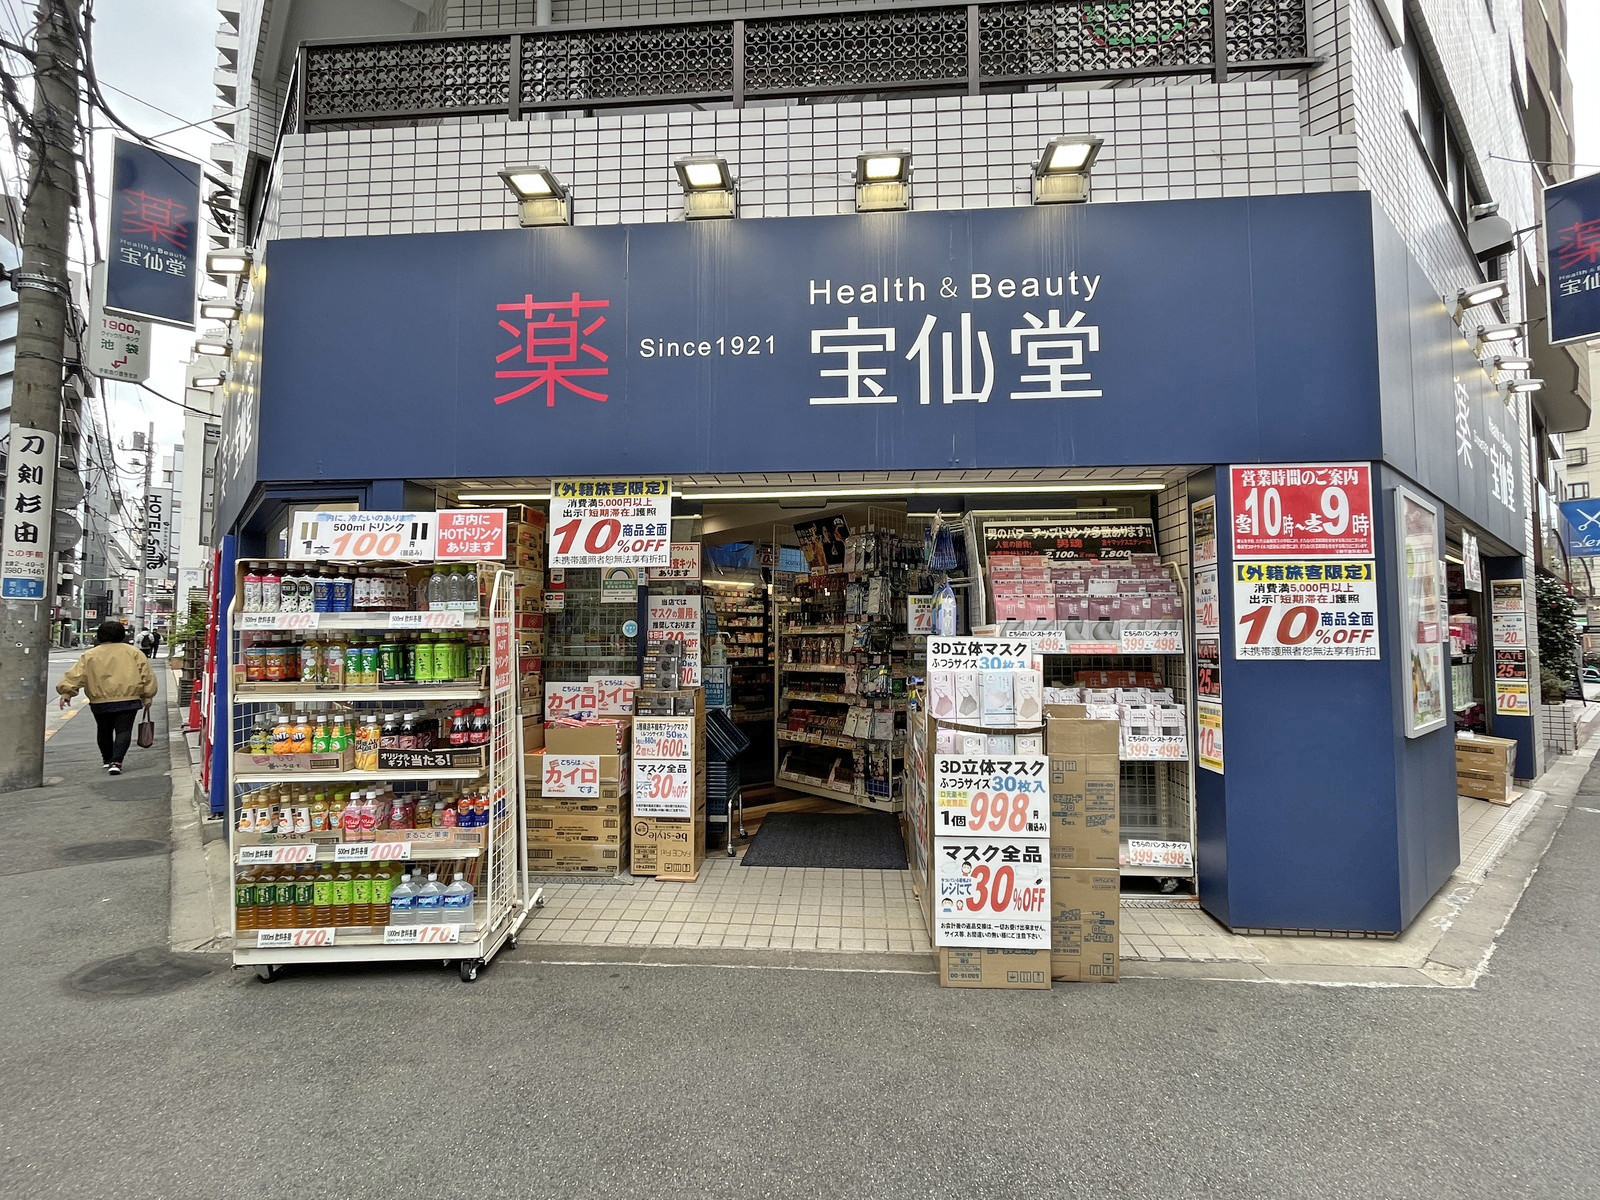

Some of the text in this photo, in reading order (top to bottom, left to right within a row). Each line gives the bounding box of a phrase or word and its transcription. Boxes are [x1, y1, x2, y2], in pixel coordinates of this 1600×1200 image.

[120, 189, 188, 249] 薬
[119, 238, 149, 251] Health
[157, 247, 187, 261] Beauty
[120, 247, 186, 277] 宝仙堂
[810, 270, 1101, 305] Health & Beauty
[494, 292, 610, 407] 薬
[809, 309, 1103, 405] 宝仙堂
[1241, 468, 1358, 487] 営業時間のご案内
[14, 435, 45, 544] 刀剣杉田
[333, 522, 405, 532] 500ml ドリンク
[452, 514, 490, 526] 店内に
[146, 494, 163, 570] HOTEL Smile
[439, 526, 502, 540] HOTドリンク
[553, 518, 667, 555] 10 商品全面
[302, 540, 330, 556] 1本
[332, 532, 402, 556] 100
[446, 542, 494, 553] あります
[661, 598, 687, 606] 当店では
[1239, 606, 1374, 645] 10 商品全面
[1315, 629, 1374, 645] %OFF
[931, 642, 1028, 657] 3D立体マスク
[1198, 645, 1218, 659] KATE
[1497, 652, 1524, 660] KATE
[931, 658, 978, 669] ふつうサイズ
[1497, 664, 1515, 677] 25
[547, 693, 596, 710] カイロ
[1498, 694, 1518, 708] 10
[655, 738, 683, 757] 1600
[545, 766, 597, 785] カイロ
[637, 764, 687, 774] マスク全品
[940, 759, 1045, 777] 3D立体マスク
[939, 776, 1046, 793] ふつうサイズ 30枚入
[941, 811, 966, 827] 1個
[968, 792, 1030, 832] 998
[648, 830, 688, 843] be-style
[275, 846, 309, 862] 100
[370, 844, 403, 860] 100
[942, 845, 1042, 863] マスク全品
[941, 883, 972, 895] レジにて
[294, 929, 327, 946] 170
[419, 927, 452, 942] 170
